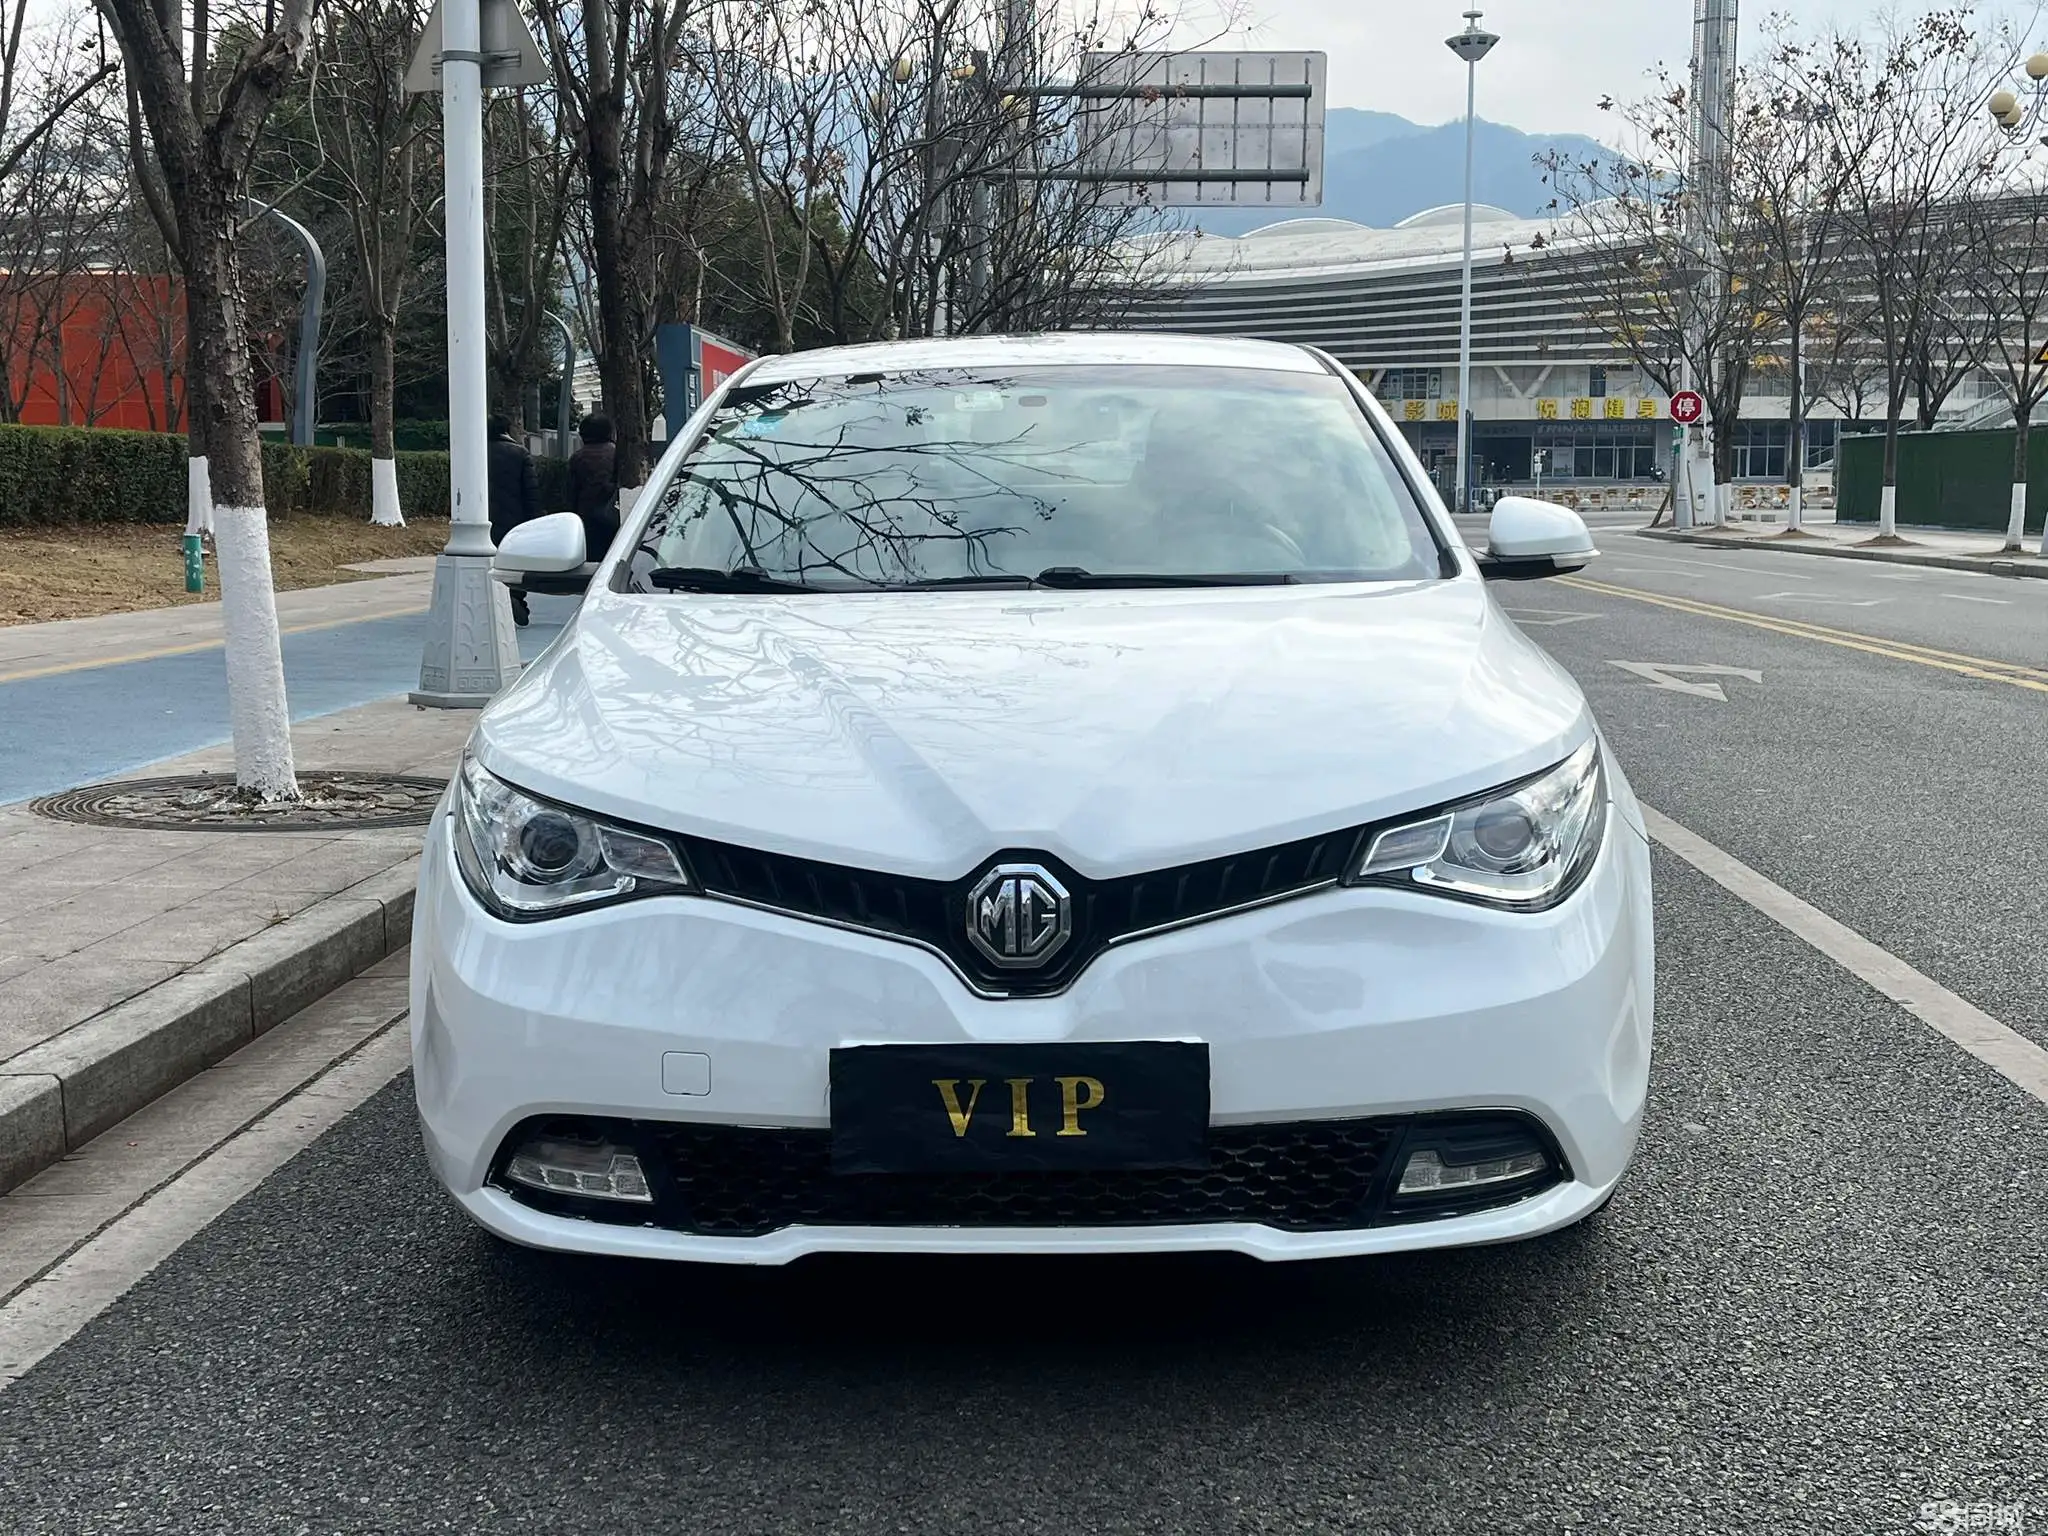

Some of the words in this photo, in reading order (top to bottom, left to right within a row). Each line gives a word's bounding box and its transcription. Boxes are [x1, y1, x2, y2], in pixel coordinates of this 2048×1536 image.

[1677, 397, 1696, 417] 停
[980, 879, 1057, 953] MG
[931, 1076, 1105, 1137] VIP
